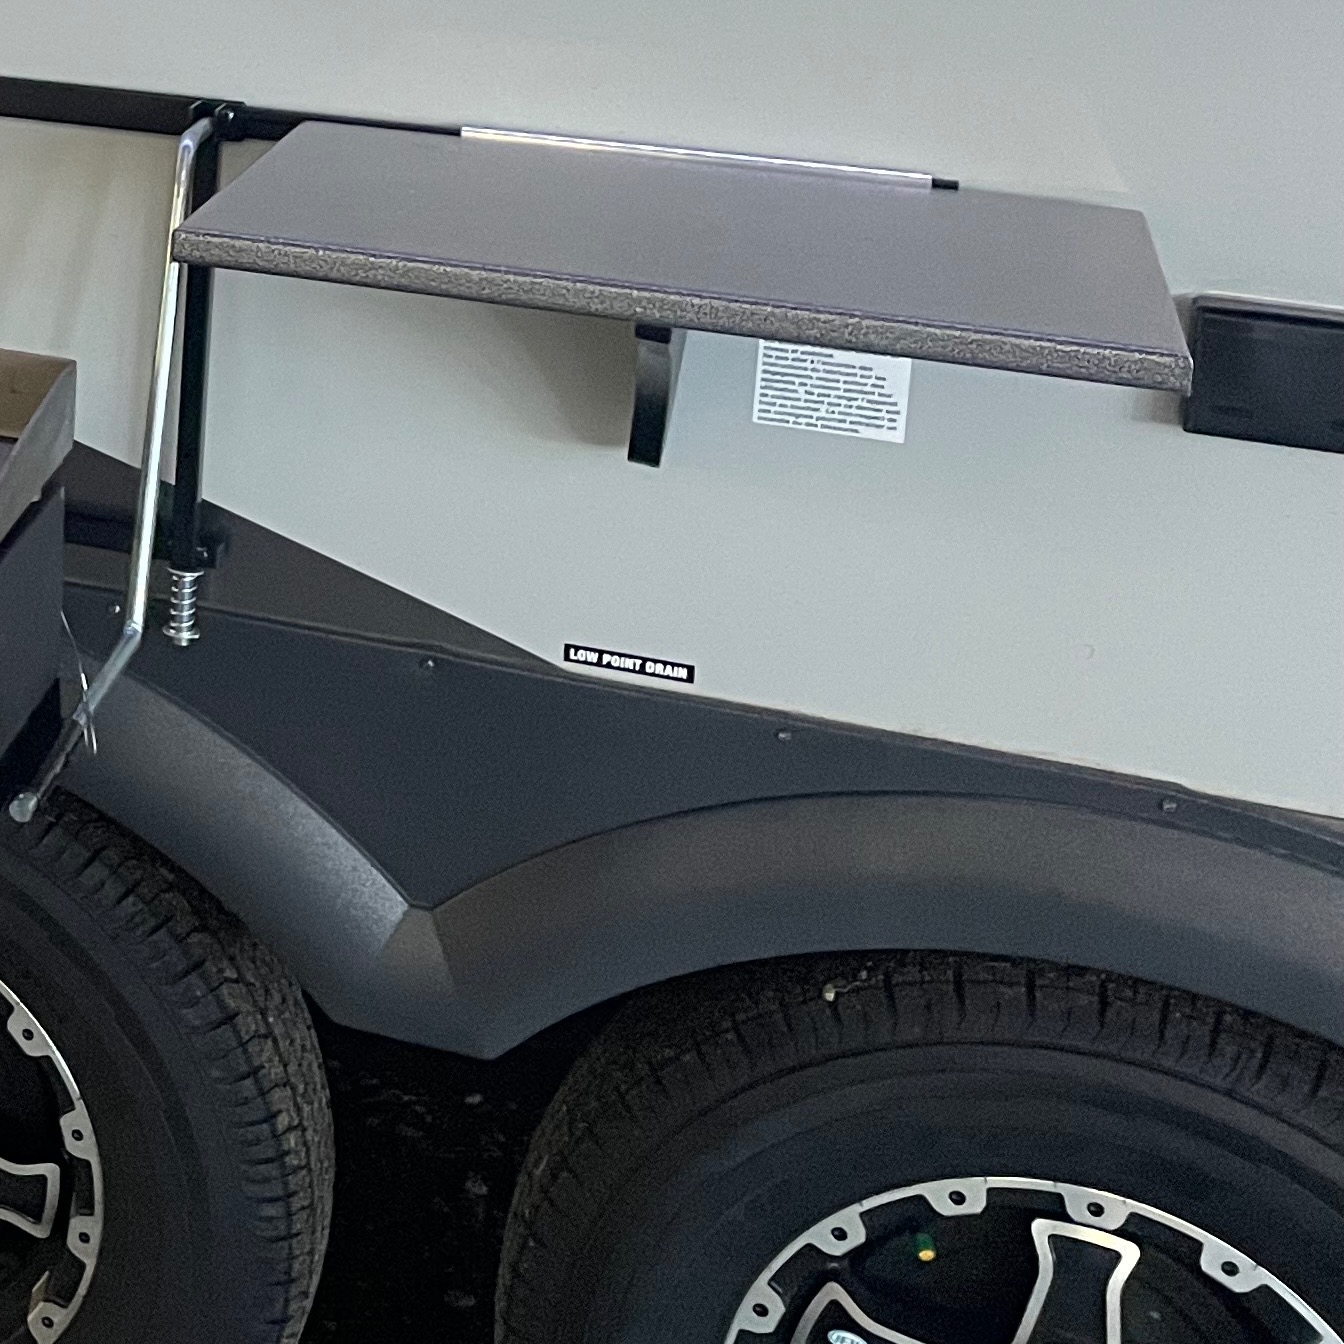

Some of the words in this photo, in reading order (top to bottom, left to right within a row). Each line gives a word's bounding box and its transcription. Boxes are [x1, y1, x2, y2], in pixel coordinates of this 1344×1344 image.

[569, 647, 599, 664] LOW
[602, 653, 643, 671] POINT
[645, 661, 688, 680] DRAIN
